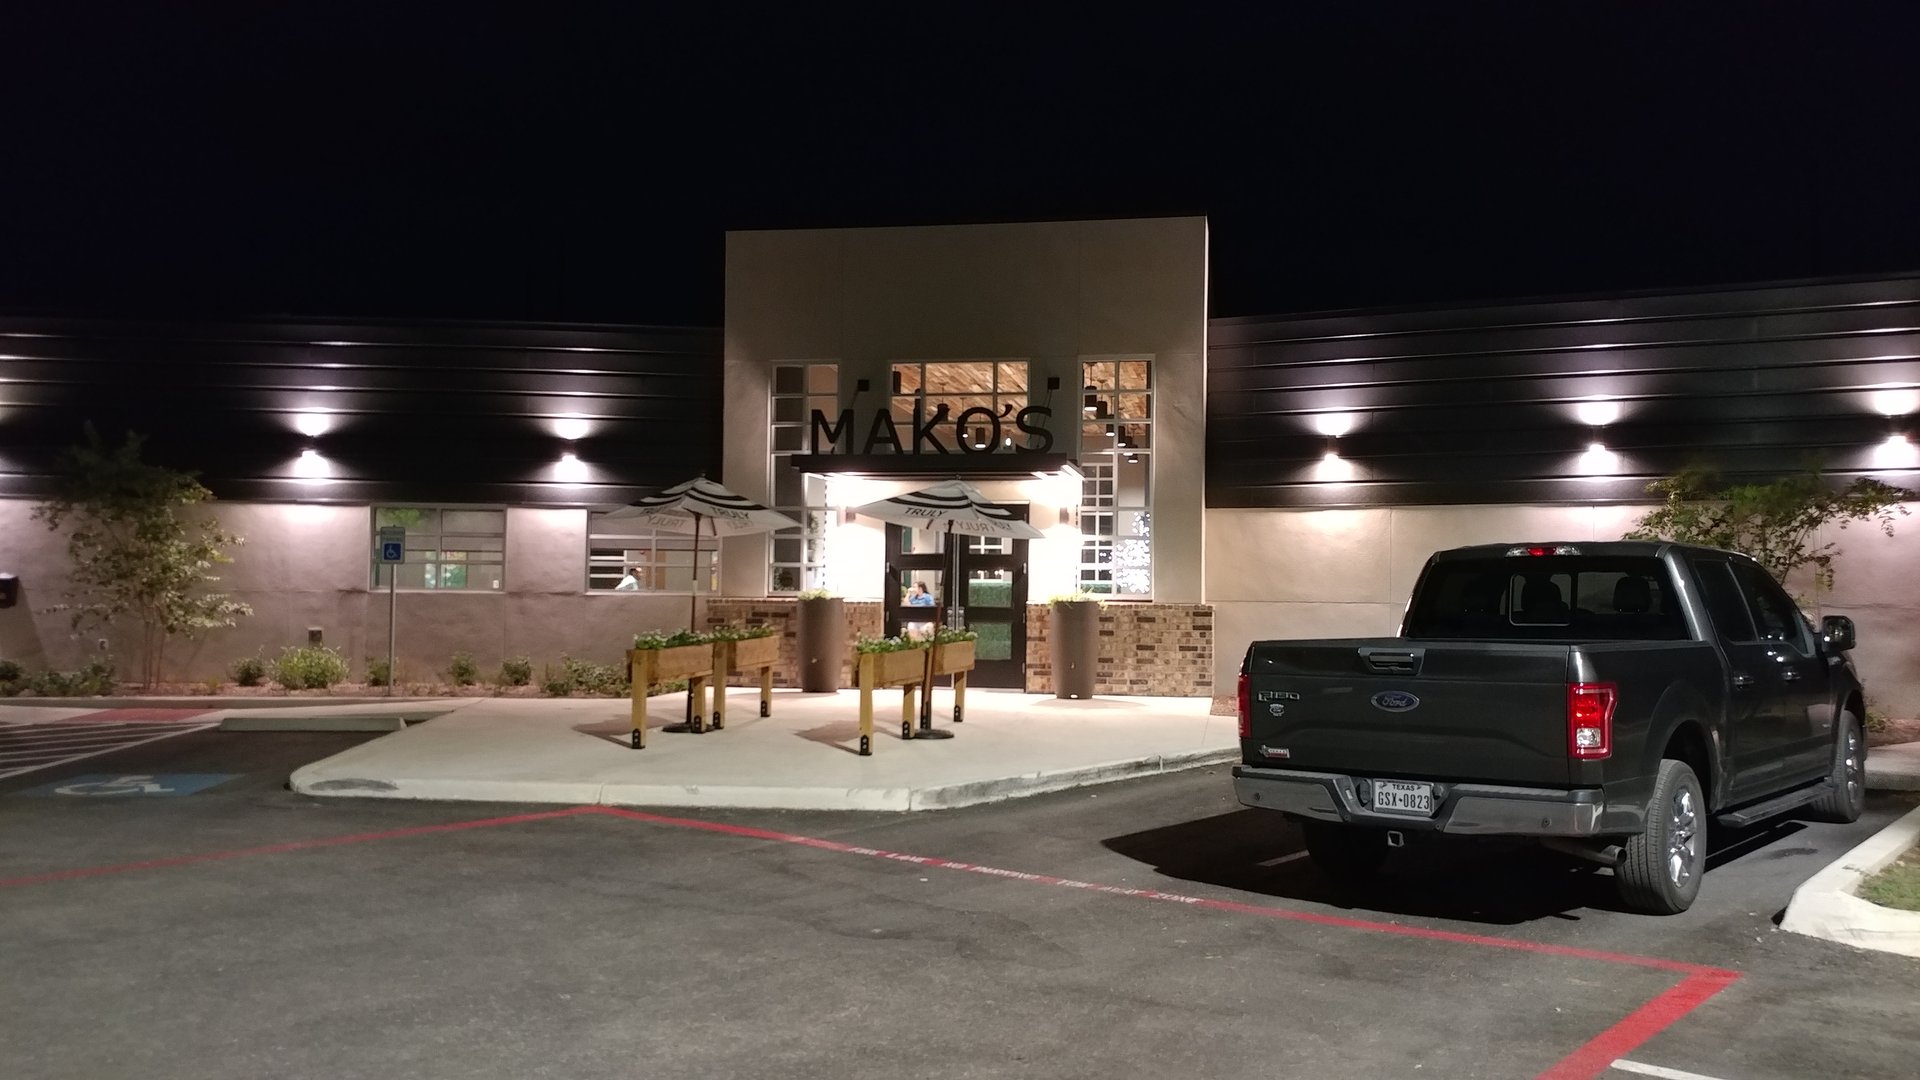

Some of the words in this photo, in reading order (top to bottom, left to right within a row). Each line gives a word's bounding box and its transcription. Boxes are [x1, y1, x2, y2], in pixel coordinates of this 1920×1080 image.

[811, 402, 1054, 455] MAKO'S
[905, 507, 948, 518] TRULY
[1393, 784, 1415, 792] TEXAS
